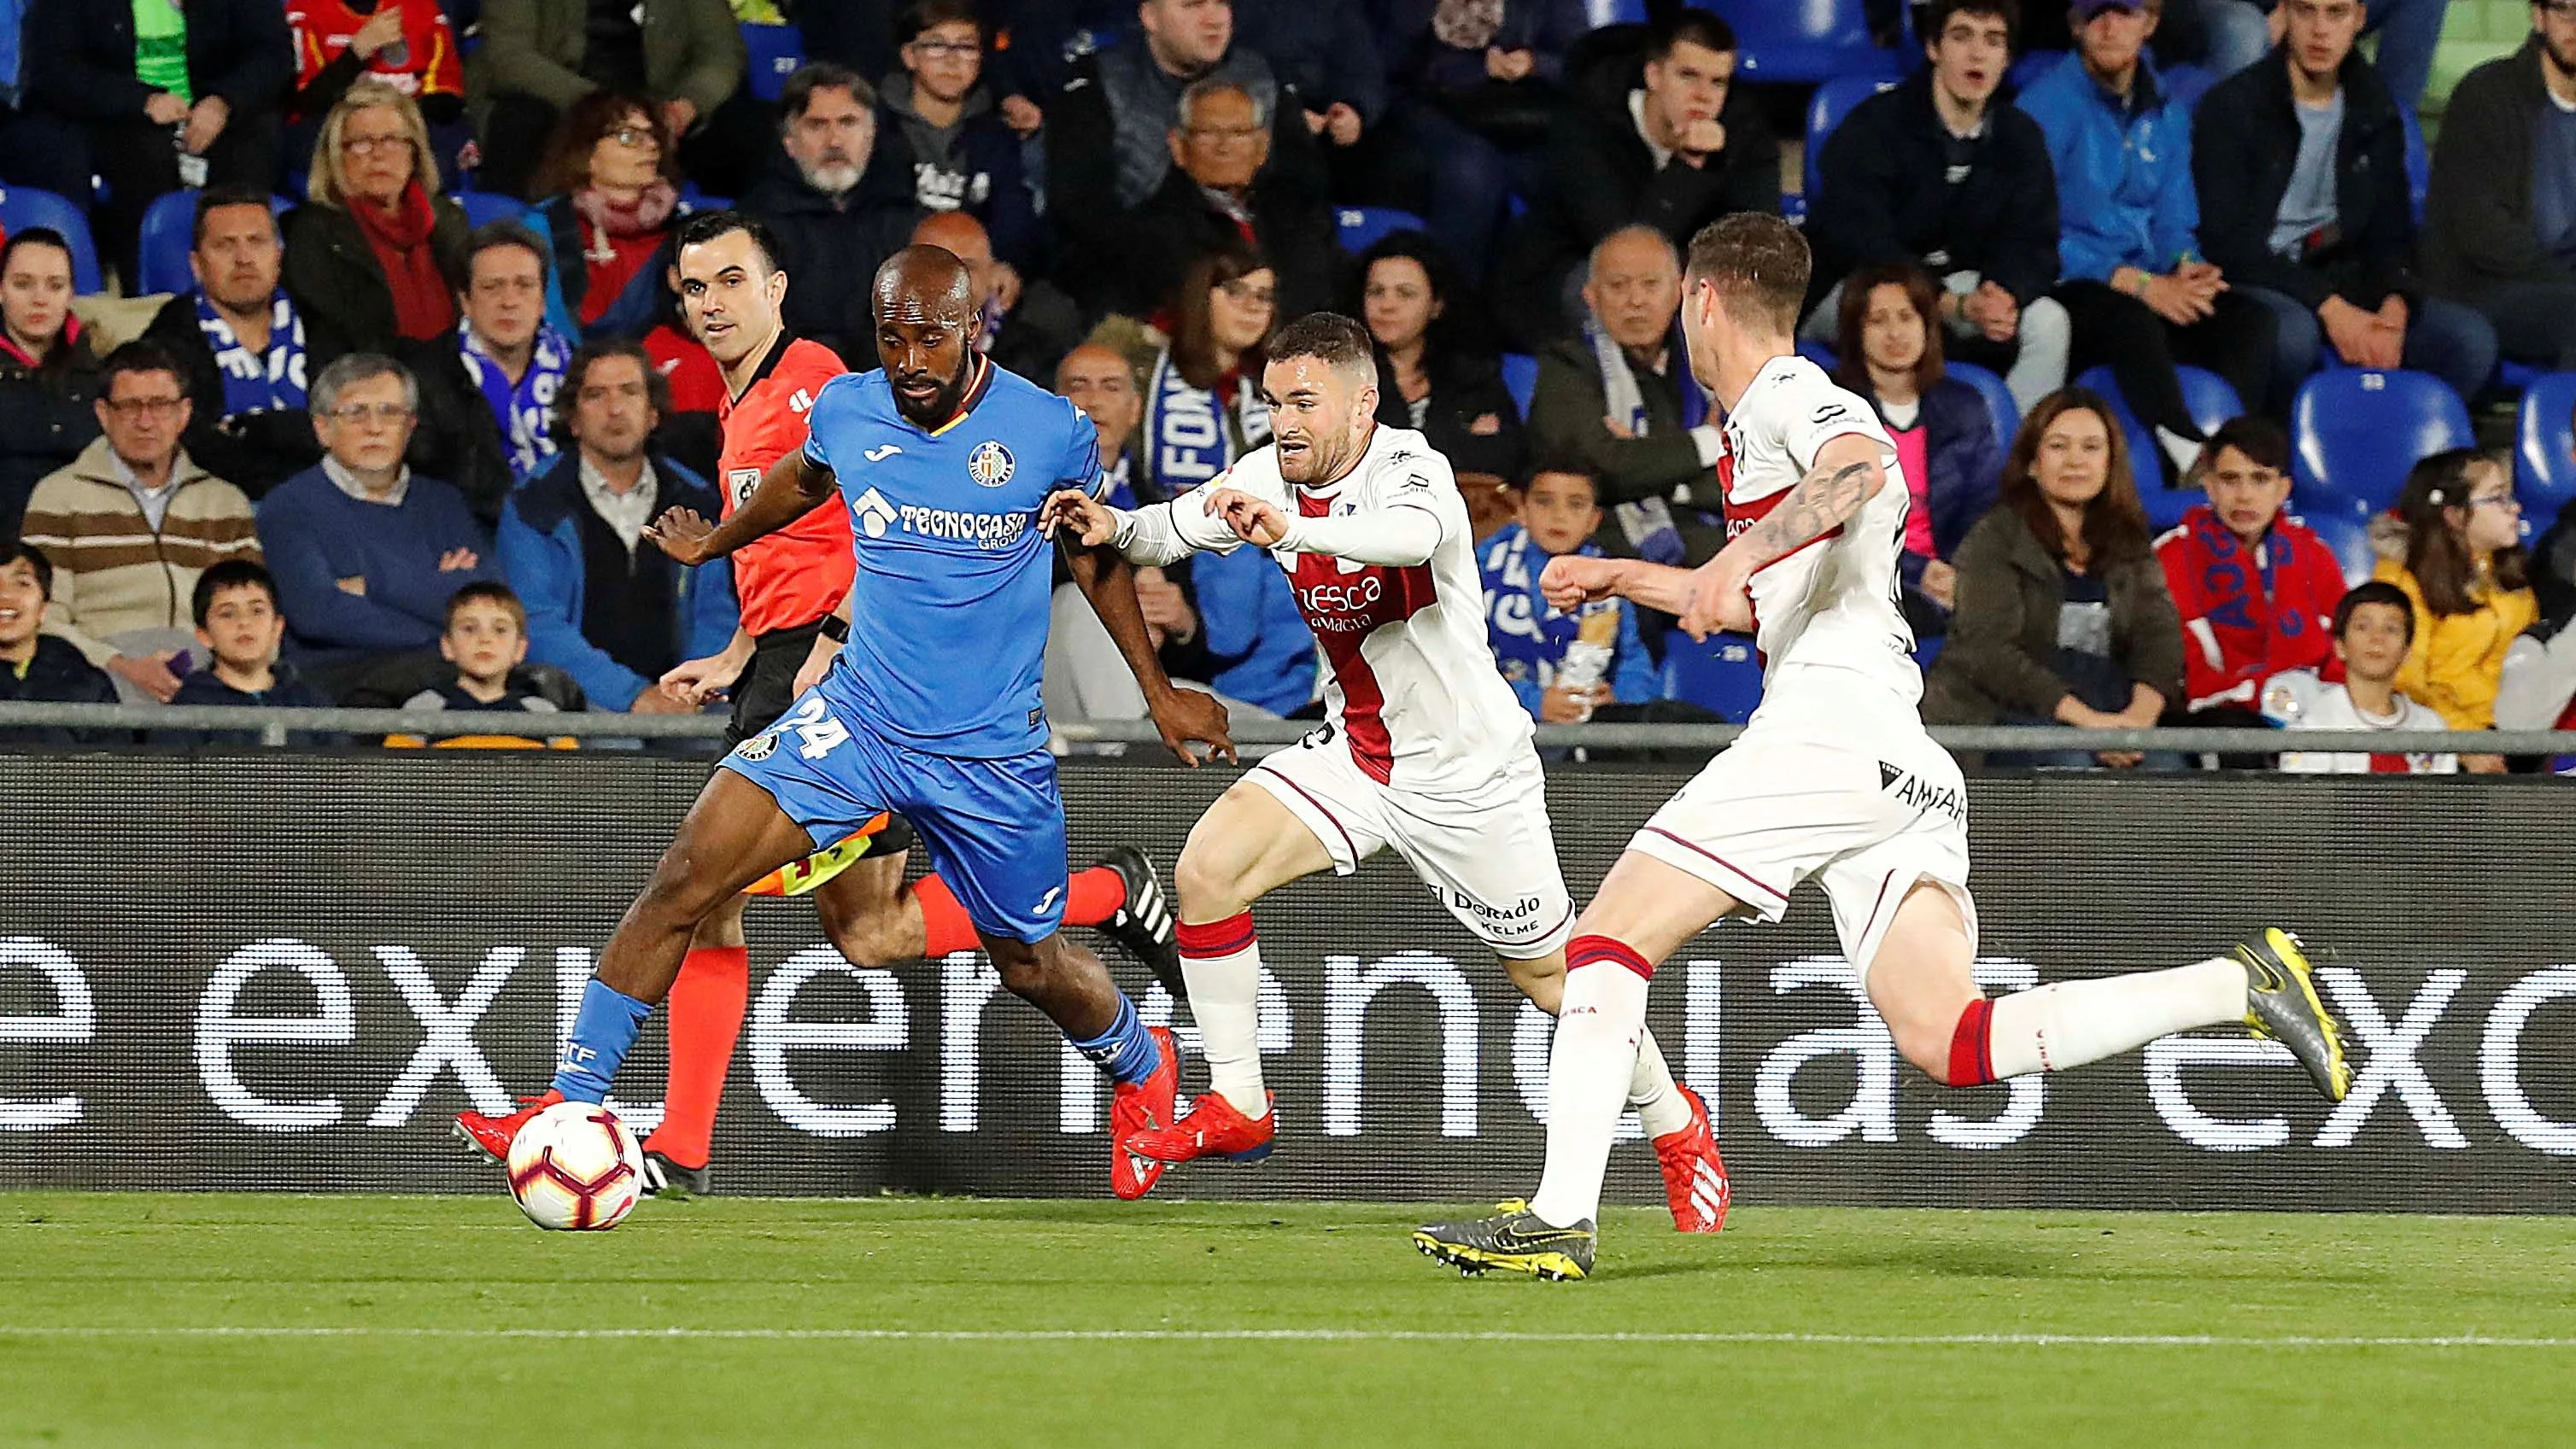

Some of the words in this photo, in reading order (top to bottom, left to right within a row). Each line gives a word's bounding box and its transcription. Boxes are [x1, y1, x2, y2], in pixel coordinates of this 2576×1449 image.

[1162, 362, 1218, 480] FON
[899, 505, 1026, 538] TECNOCASA
[769, 697, 850, 760] 24
[1481, 920, 1540, 936] KELME
[193, 936, 2047, 1149] exernias
